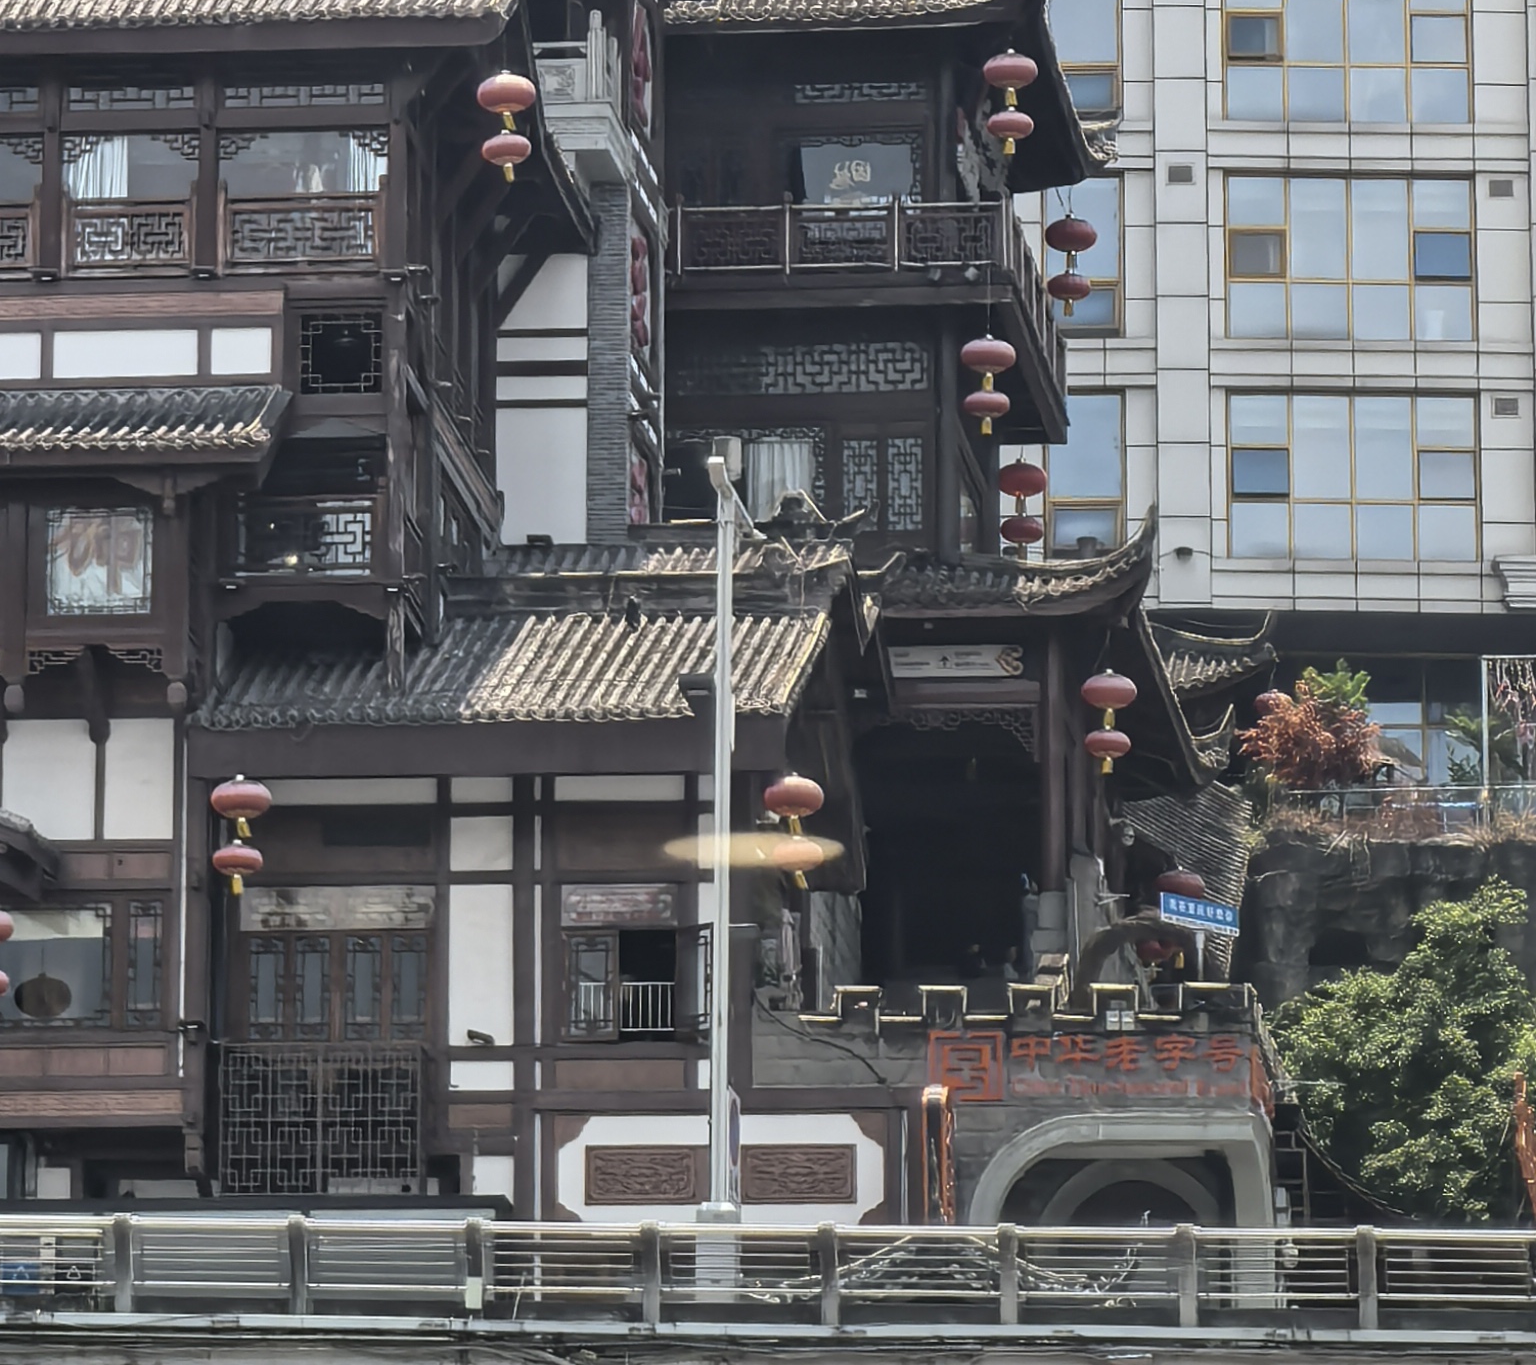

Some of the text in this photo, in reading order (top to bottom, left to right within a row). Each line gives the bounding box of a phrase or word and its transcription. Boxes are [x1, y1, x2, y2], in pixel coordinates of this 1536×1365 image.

[1011, 1034, 1245, 1072] 中华老字号
